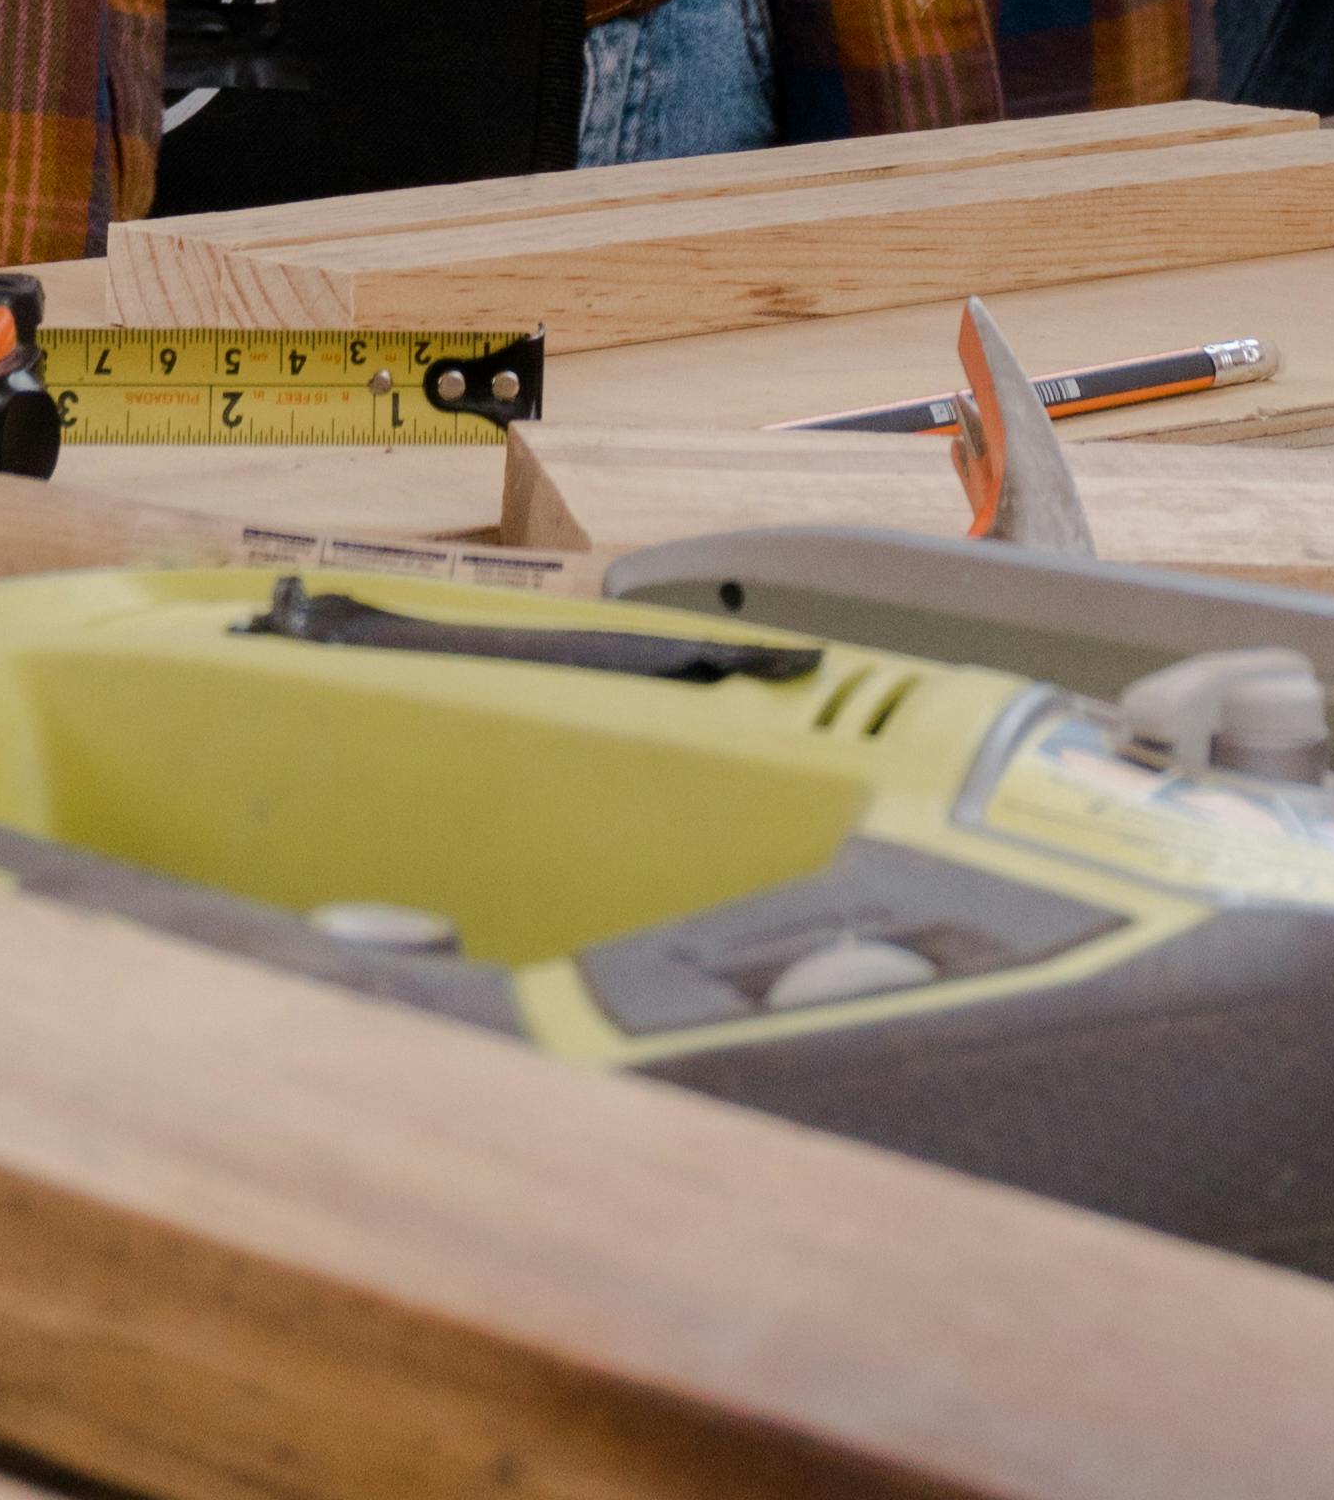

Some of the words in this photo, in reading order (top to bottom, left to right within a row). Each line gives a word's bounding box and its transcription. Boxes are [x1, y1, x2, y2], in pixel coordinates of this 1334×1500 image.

[94, 348, 112, 375] 7
[159, 348, 178, 375] 6
[224, 348, 242, 375] 5
[288, 349, 307, 375] 4
[350, 340, 367, 365] 3
[414, 341, 432, 366] 2
[56, 389, 79, 428] 3
[123, 390, 200, 406] PULGADAS
[222, 391, 243, 428] 2
[276, 391, 310, 405] FEET
[391, 391, 404, 428] 1
